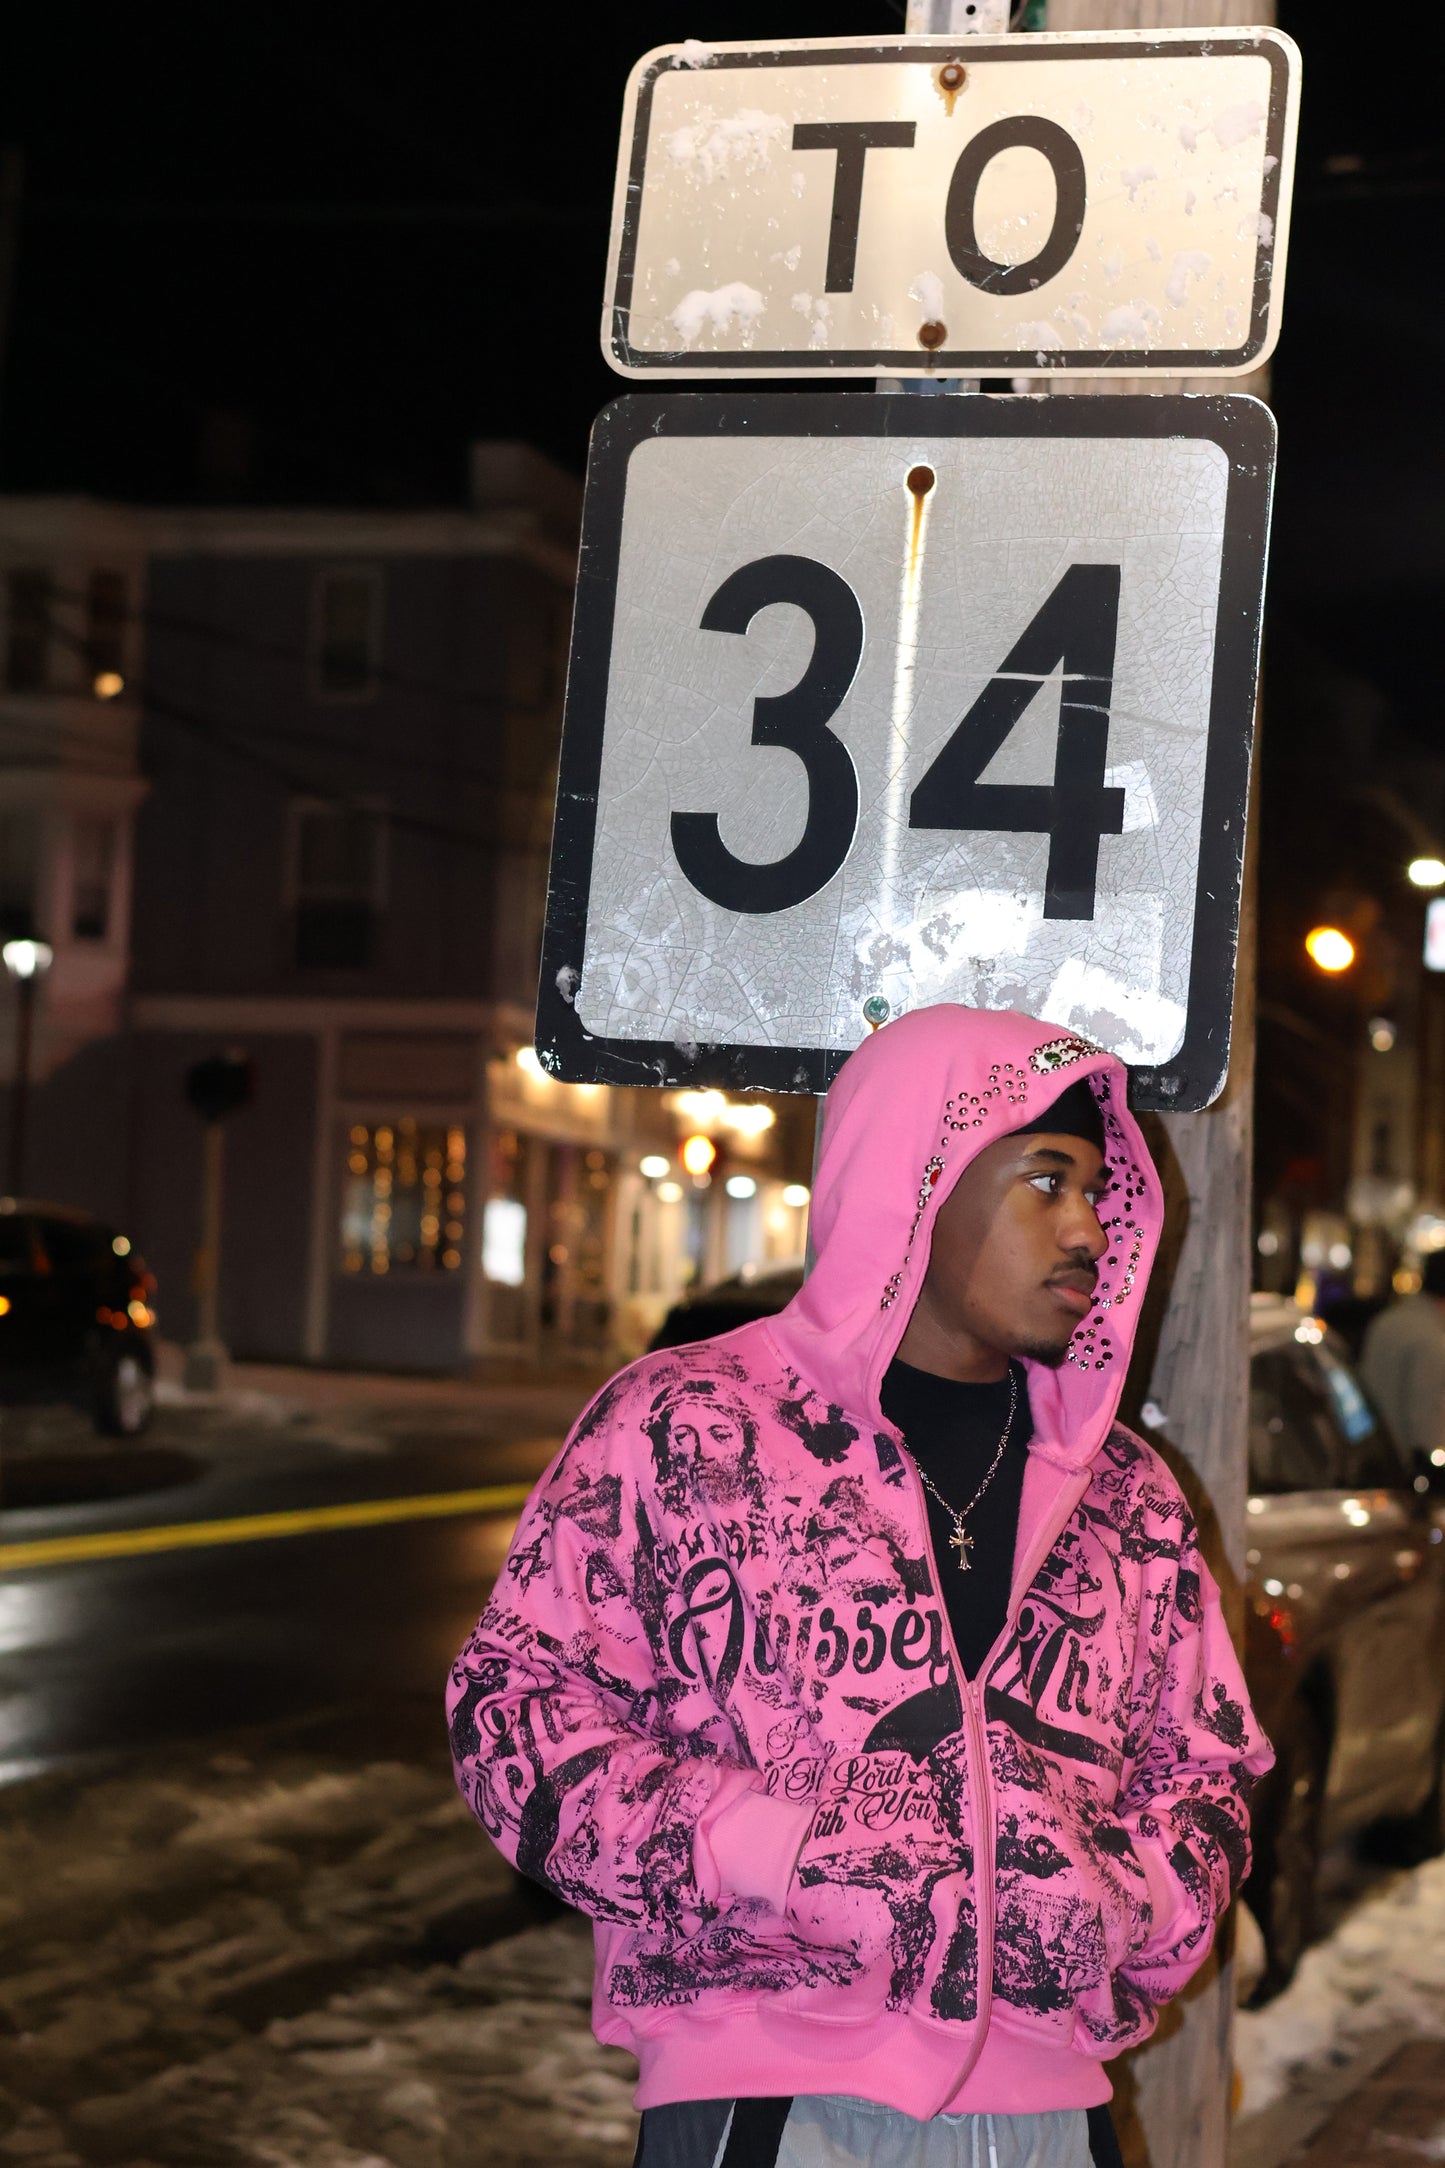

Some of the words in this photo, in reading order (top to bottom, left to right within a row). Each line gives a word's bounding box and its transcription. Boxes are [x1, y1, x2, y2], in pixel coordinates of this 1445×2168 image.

[791, 114, 1087, 296] TO
[669, 553, 1126, 921] 34
[829, 1752, 908, 1798] Lord
[853, 1788, 933, 1832] You
